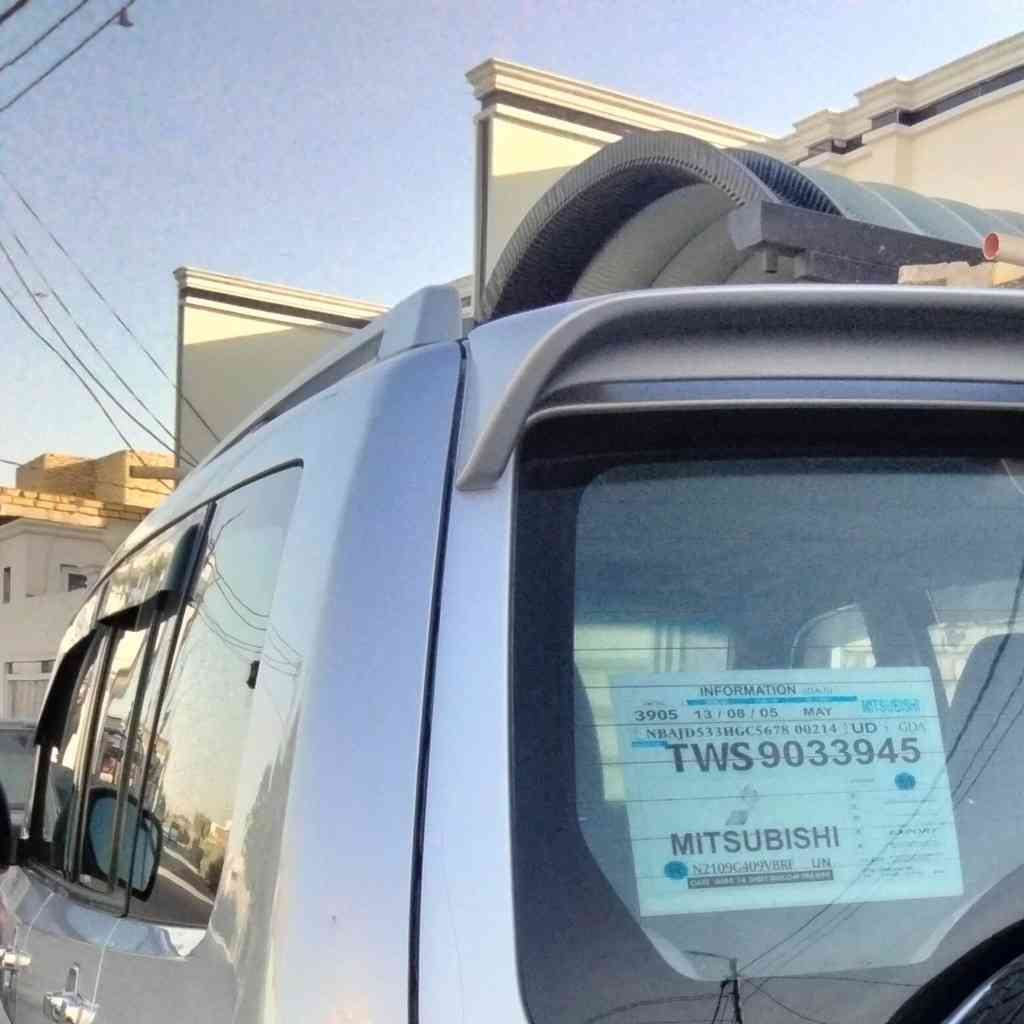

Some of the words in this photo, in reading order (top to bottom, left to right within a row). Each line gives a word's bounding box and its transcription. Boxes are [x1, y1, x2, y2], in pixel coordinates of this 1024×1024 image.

[700, 683, 797, 697] INFORMATION
[634, 709, 679, 722] 3905
[802, 706, 833, 718] MAY
[852, 721, 878, 735] UD
[670, 825, 840, 857] MITSUBISHI
